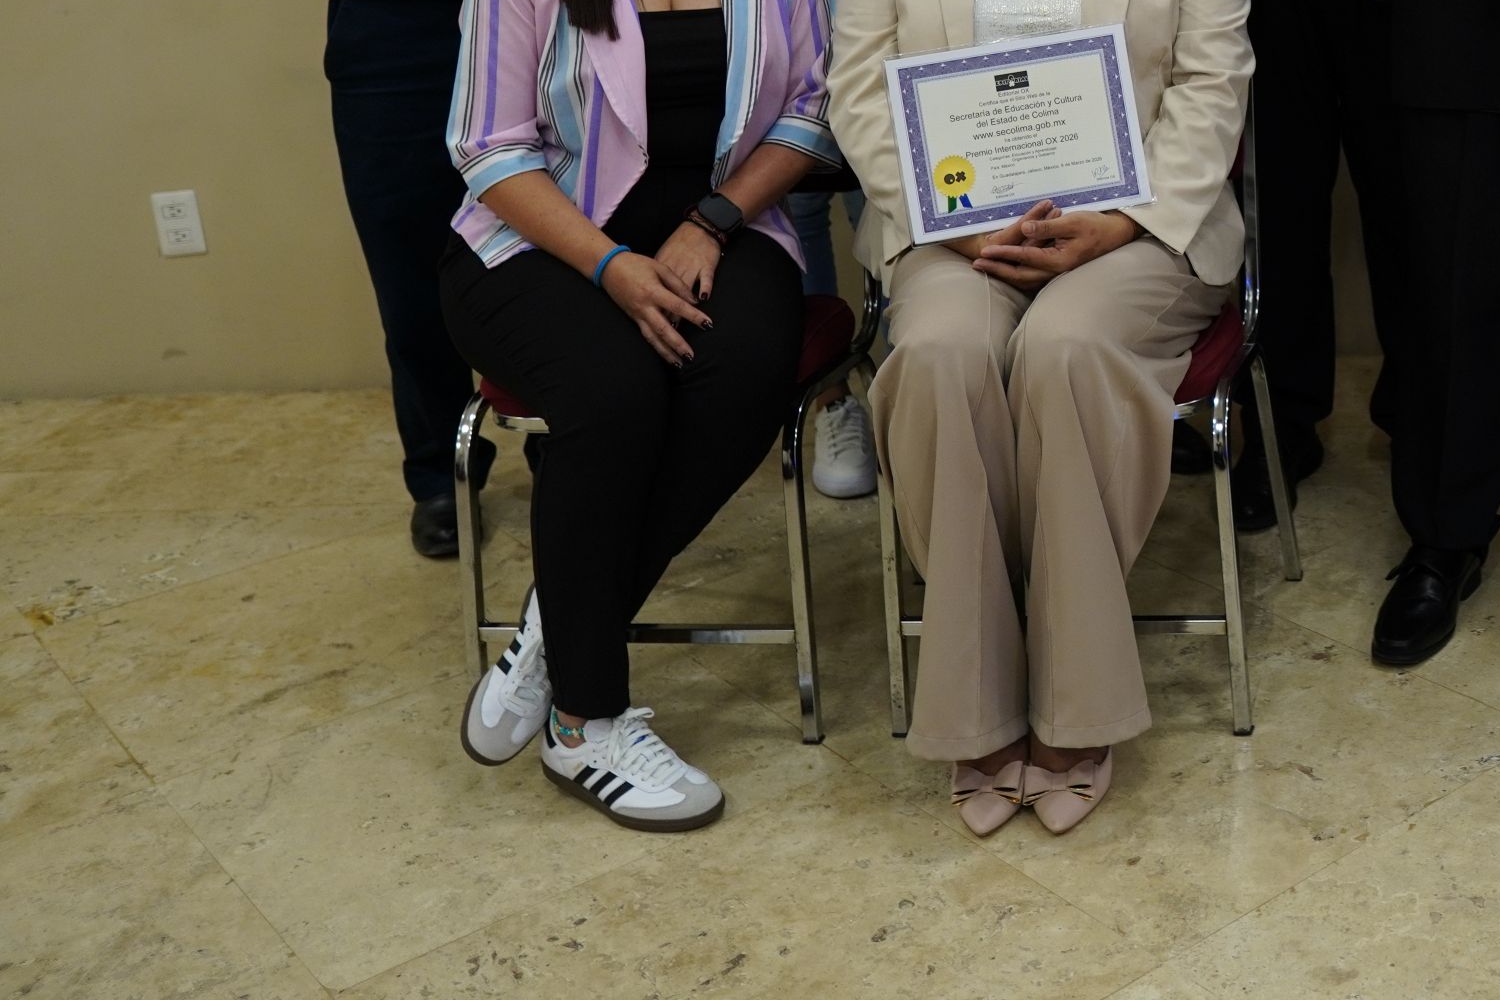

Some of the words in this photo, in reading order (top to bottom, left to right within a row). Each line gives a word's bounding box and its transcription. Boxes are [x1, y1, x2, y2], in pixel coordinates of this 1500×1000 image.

[1005, 100, 1045, 114] Educación
[1054, 94, 1082, 105] Cultura
[976, 120, 988, 128] del
[991, 115, 1018, 126] Estado
[1032, 108, 1059, 118] Colima
[966, 148, 993, 159] Premio
[995, 139, 1043, 154] Internacional
[1060, 133, 1078, 143] 2026
